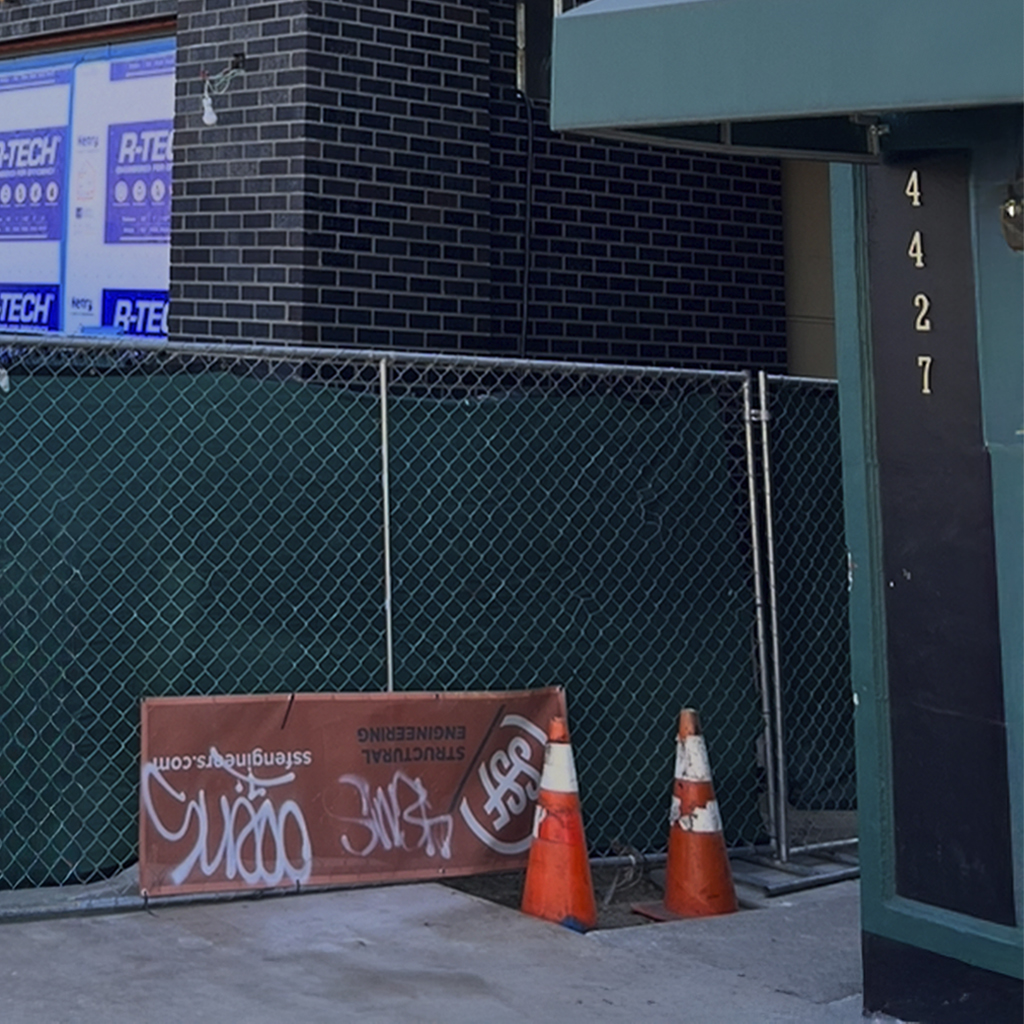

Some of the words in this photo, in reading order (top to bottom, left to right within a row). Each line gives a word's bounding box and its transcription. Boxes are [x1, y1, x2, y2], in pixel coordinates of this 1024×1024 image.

[905, 170, 931, 394] 4427
[357, 725, 466, 743] ENGINEERING
[361, 745, 466, 764] STRUCTURAL
